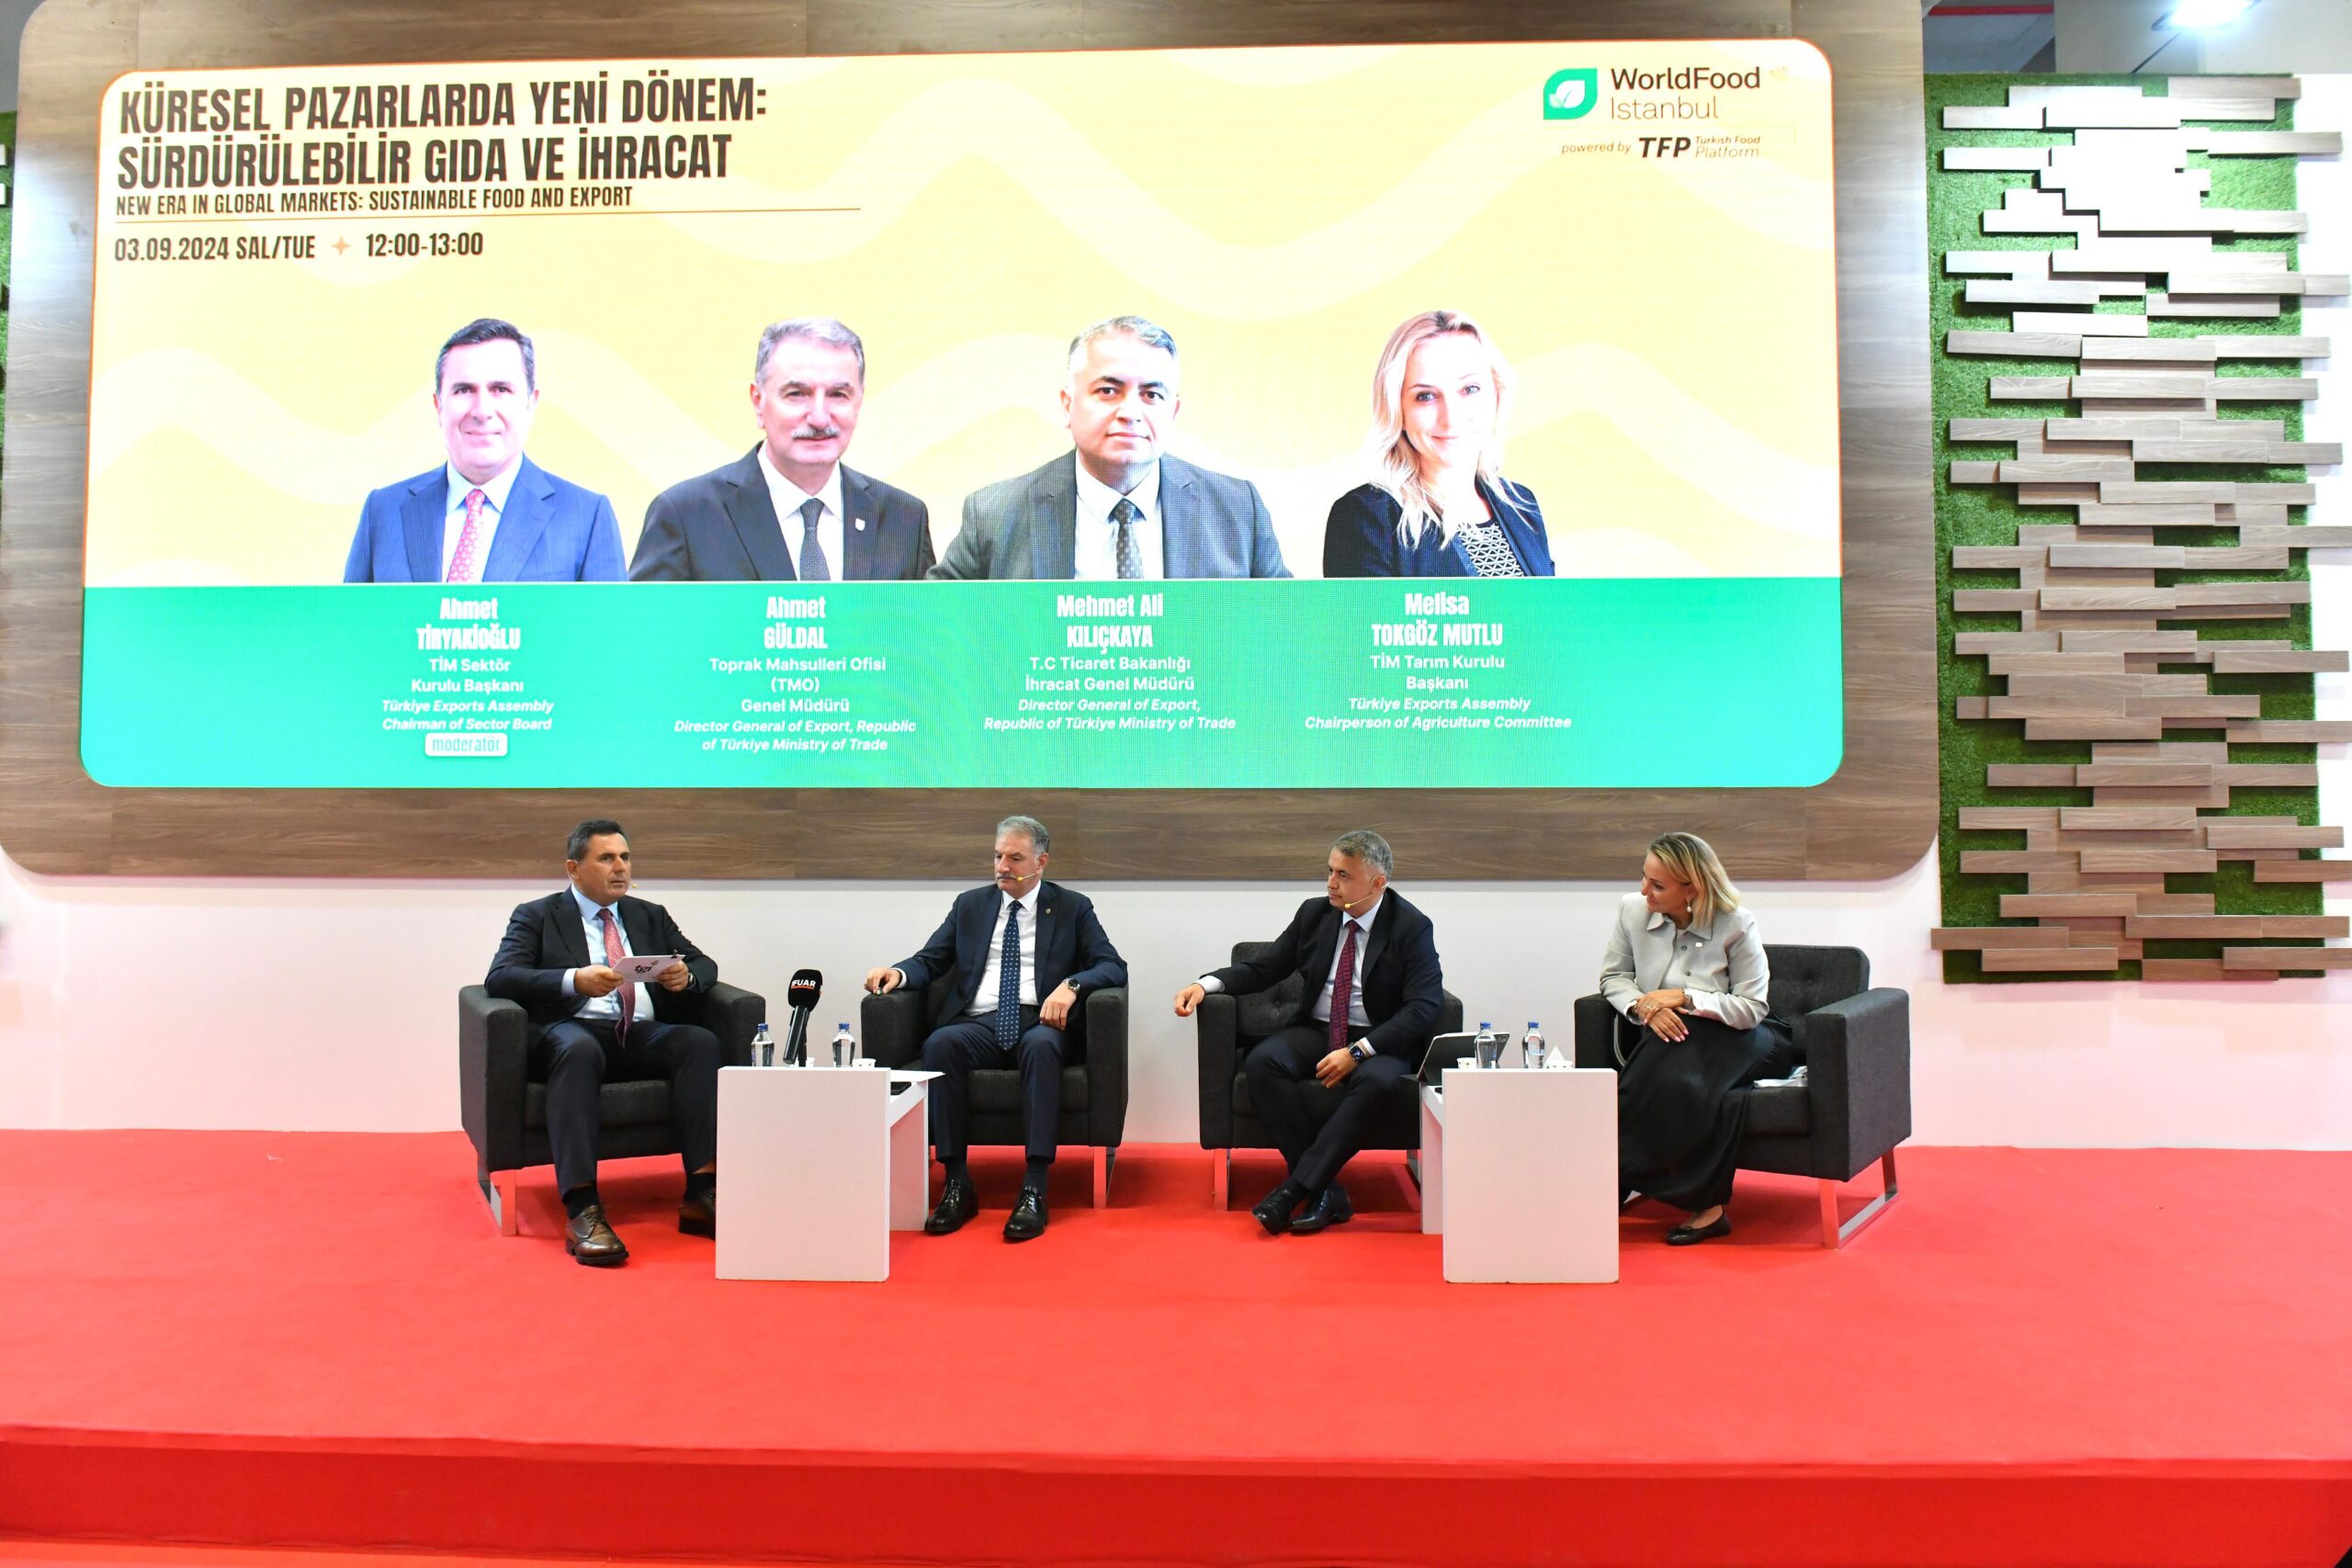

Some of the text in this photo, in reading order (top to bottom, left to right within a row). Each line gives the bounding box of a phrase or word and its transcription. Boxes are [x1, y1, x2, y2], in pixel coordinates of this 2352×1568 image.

[1611, 66, 1760, 90] WorldFood
[120, 70, 766, 133] KÜRESEL PAZARLARDA YENİ DÖNEM:
[1611, 96, 1719, 120] Istanbul
[1562, 137, 1691, 158] powered by TFP
[1695, 136, 1760, 144] Turkish Food
[118, 127, 731, 189] SÜRDÜRÜLEBİLİR GIDA VE İHRACAT
[1695, 145, 1760, 158] Platform
[117, 186, 633, 216] NEW ERA IN GLOBAL MARKETS: SUSTAINABLE FOOD AND EXPORT
[115, 235, 315, 261] 03.09.2024 SAL/TUE
[366, 232, 483, 256] 12:00-13:00
[439, 597, 498, 620] Ahmet
[766, 596, 826, 618] Ahmet
[1057, 592, 1163, 617] Mehmet Ali
[1405, 592, 1469, 615] Melisa
[416, 623, 521, 649] TİRYAKİOĞLU
[763, 623, 828, 649] GÜLDAL
[1067, 625, 1153, 654] KILIÇKAYA
[1371, 619, 1503, 647] TOKGÖZ MUTLU
[429, 656, 511, 671] TİM Sektör
[709, 657, 887, 674] Toprak Mahsulleri Ofisi
[1029, 656, 1191, 673] T.C Ticaret Bakanlığı
[1370, 652, 1505, 670] TİM Tarım Kurulu
[411, 679, 524, 695] Kurulu Başkanı
[771, 677, 820, 693] (TMO)
[1025, 673, 1194, 691] İhracat Genel Müdürü
[1406, 676, 1469, 693] Başkanı
[382, 700, 554, 715] Türkiye Exports Assembly
[741, 697, 850, 712] Genel Müdürü
[1018, 698, 1201, 714] Director General of Export,
[1349, 697, 1531, 713] Türkiye Exports Assembly
[382, 717, 552, 730] Chairman of Sector Board
[674, 719, 917, 735] Director General of Export, Republic
[984, 716, 1236, 732] Republic of Türkiye Ministry of Trade
[1305, 716, 1572, 731] Chairperson of Agriculture Committee
[432, 736, 500, 752] moderatör
[702, 738, 888, 753] of Türkiye Ministry of Trade
